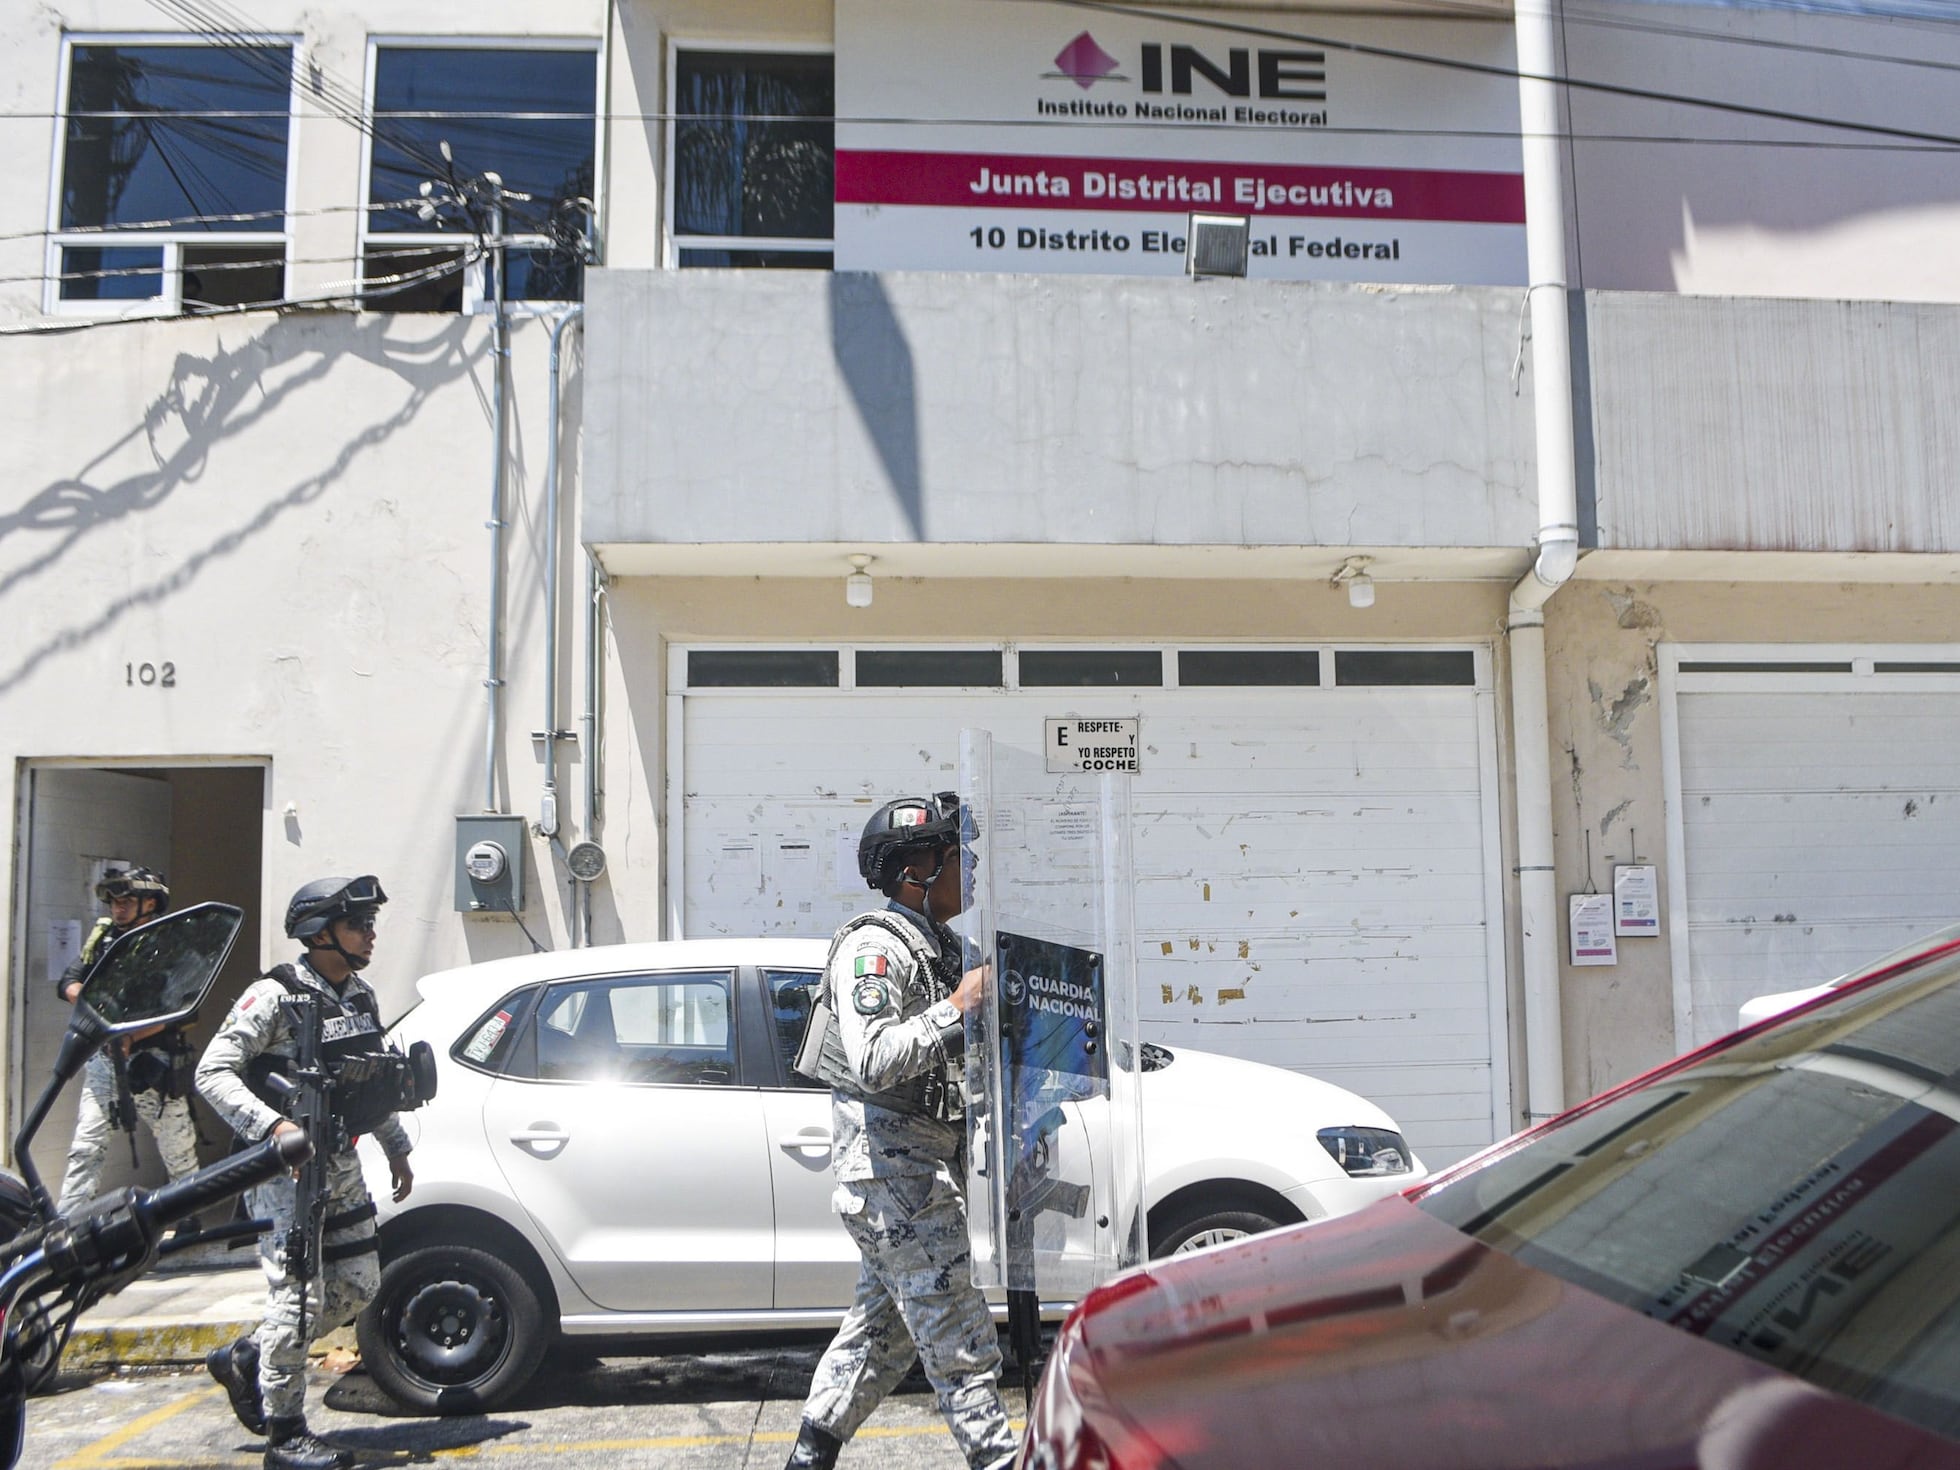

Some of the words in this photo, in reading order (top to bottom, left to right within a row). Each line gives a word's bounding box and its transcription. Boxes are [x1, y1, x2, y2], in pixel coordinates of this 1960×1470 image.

[1141, 43, 1326, 100] INE
[1038, 98, 1128, 117] Instituto
[1135, 102, 1227, 120] Nacional
[1235, 106, 1327, 125] Electoral
[970, 168, 1070, 197] Junta
[1083, 171, 1221, 202] Distrital
[1234, 177, 1394, 210] Ejecutiva
[970, 227, 1006, 249] 10
[1017, 228, 1130, 251] Distrito
[1142, 231, 1277, 257] Eleal
[1289, 236, 1400, 260] Federal
[126, 662, 176, 688] 102
[1057, 727, 1069, 746] E
[1128, 734, 1136, 745] Y
[1078, 748, 1091, 758] YO
[1093, 747, 1136, 758] RESPETO
[1082, 760, 1137, 770] COCHE
[1028, 975, 1094, 1002] GUARDIA
[1029, 994, 1101, 1022] NACIONAL
